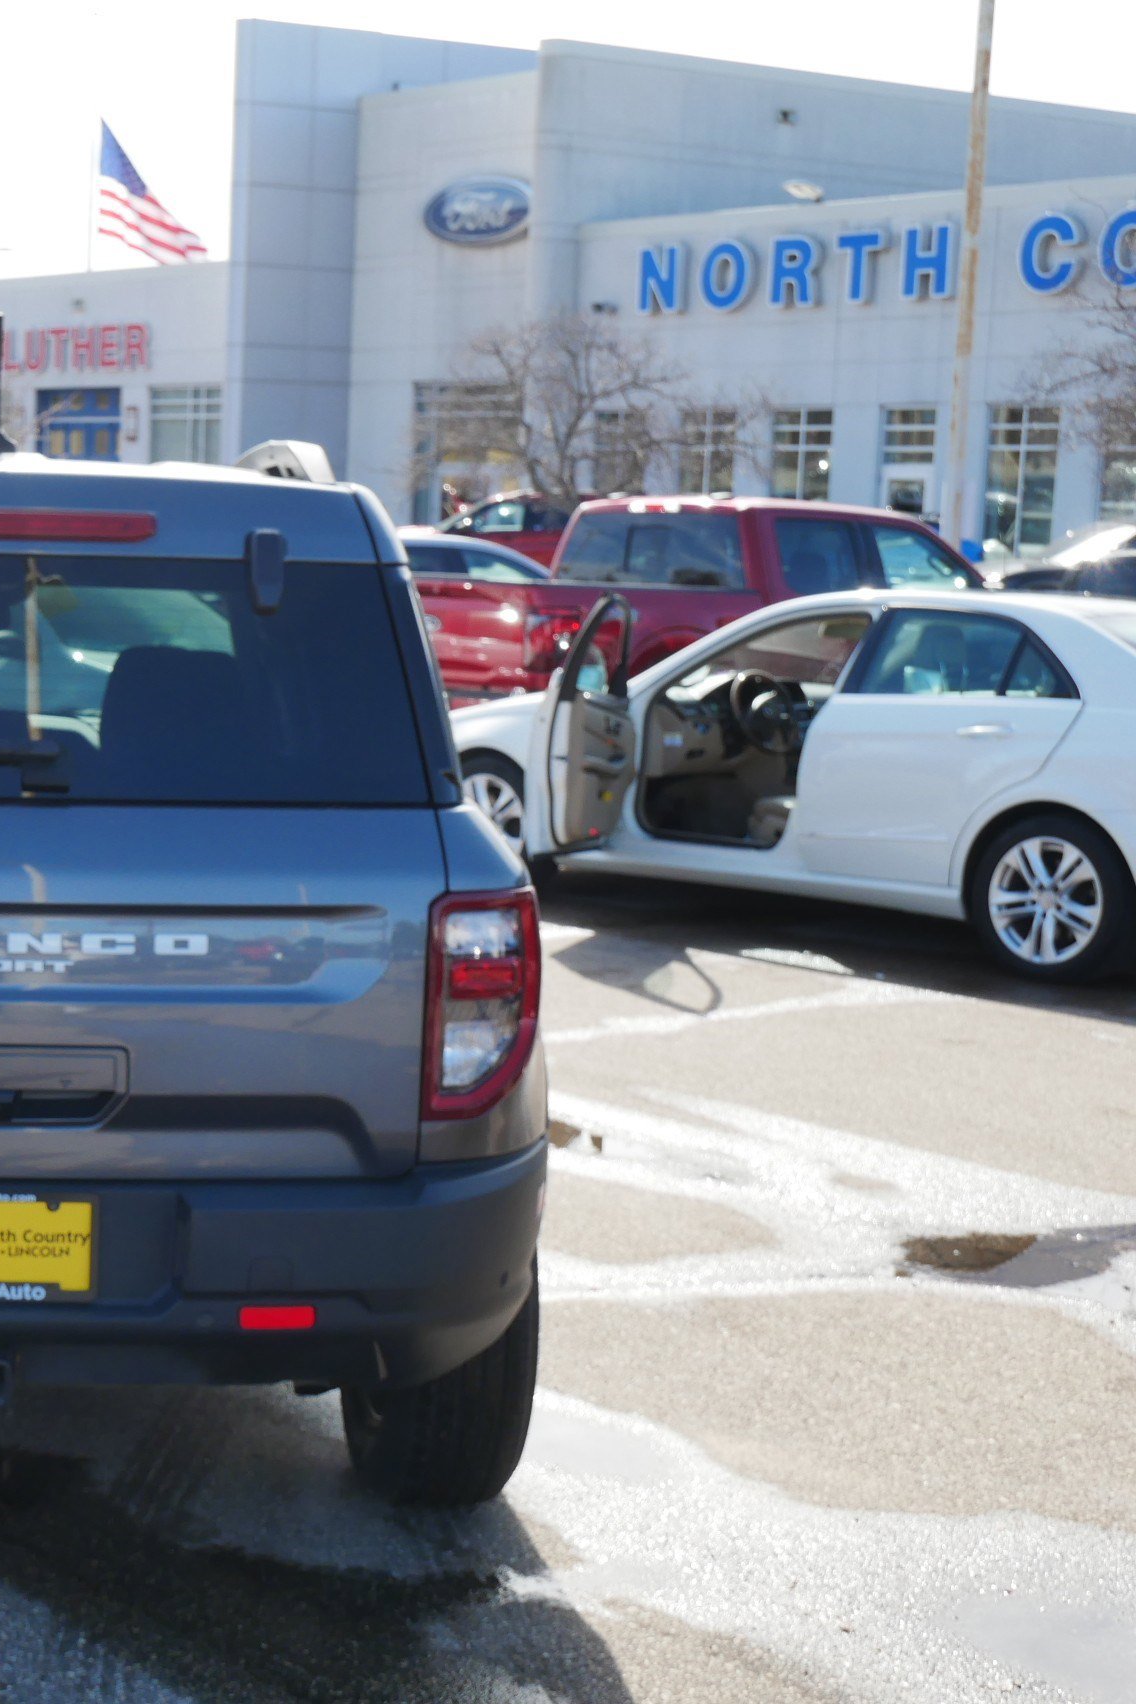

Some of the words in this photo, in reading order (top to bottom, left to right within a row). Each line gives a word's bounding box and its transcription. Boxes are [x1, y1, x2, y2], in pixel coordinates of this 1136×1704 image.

[639, 221, 952, 313] NORTH
[2, 323, 148, 372] LUTHER
[23, 1229, 90, 1245] Country
